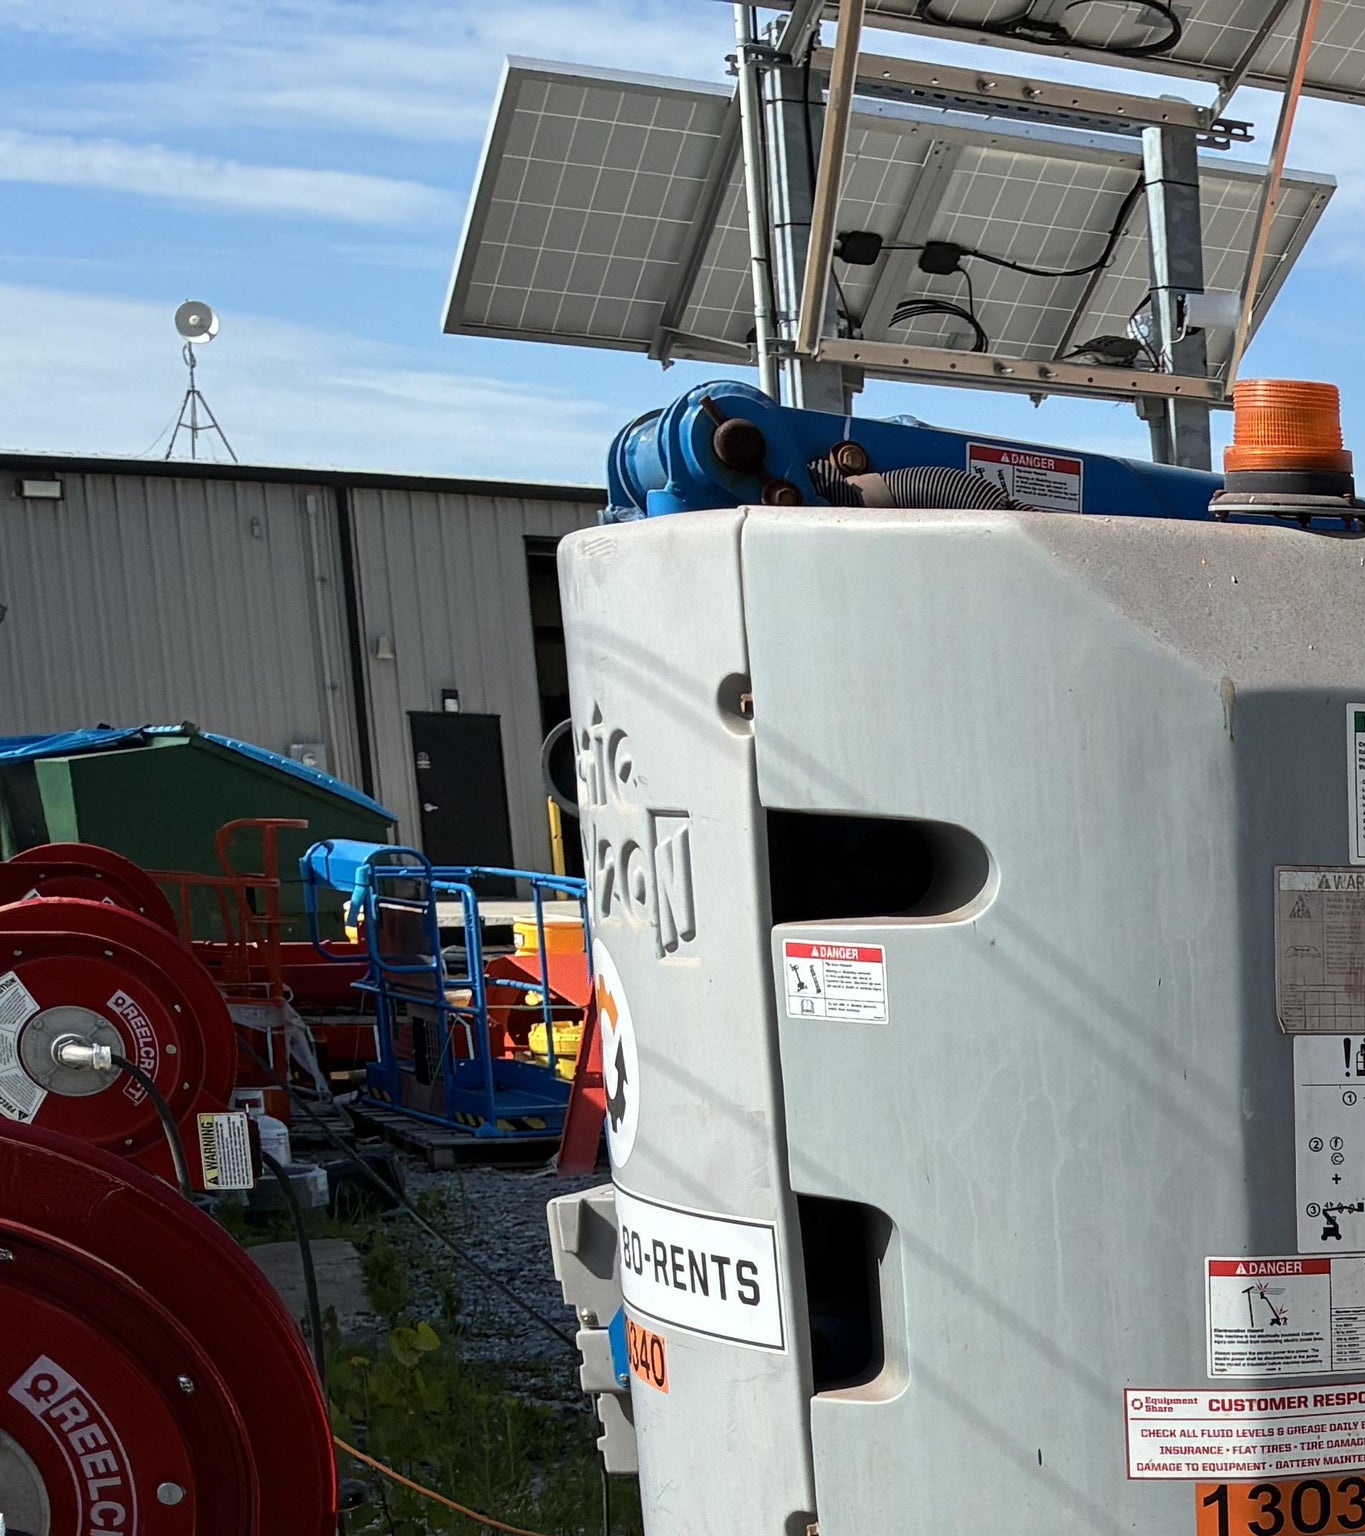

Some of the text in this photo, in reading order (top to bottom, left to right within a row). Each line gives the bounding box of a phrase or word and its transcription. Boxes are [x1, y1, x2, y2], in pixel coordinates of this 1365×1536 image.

[1011, 454, 1055, 470] DANGER
[820, 946, 860, 960] DANGER
[200, 1122, 218, 1170] WARNING
[1250, 1261, 1303, 1275] DANGER
[627, 1322, 667, 1388] 340
[1145, 1396, 1198, 1406] Equipment
[1209, 1396, 1308, 1413] CUSTOMER
[1145, 1405, 1174, 1413] Share
[1141, 1428, 1177, 1438] CHECK
[1179, 1428, 1199, 1438] ALL
[1201, 1428, 1233, 1438] FLUID
[1236, 1426, 1274, 1437] LEVELS
[1277, 1426, 1284, 1436] &
[1287, 1424, 1327, 1436] GREASE
[1329, 1421, 1359, 1433] DAILY
[1160, 1445, 1223, 1455] INSURANCE
[1233, 1445, 1258, 1454] FLAT
[1260, 1443, 1292, 1453] TIRES
[1300, 1440, 1324, 1450] TIRE
[1137, 1462, 1182, 1472] DAMAGE
[1185, 1462, 1200, 1471] TO
[1202, 1461, 1267, 1472] EQUIPMENT
[1276, 1458, 1321, 1470] BATTERY
